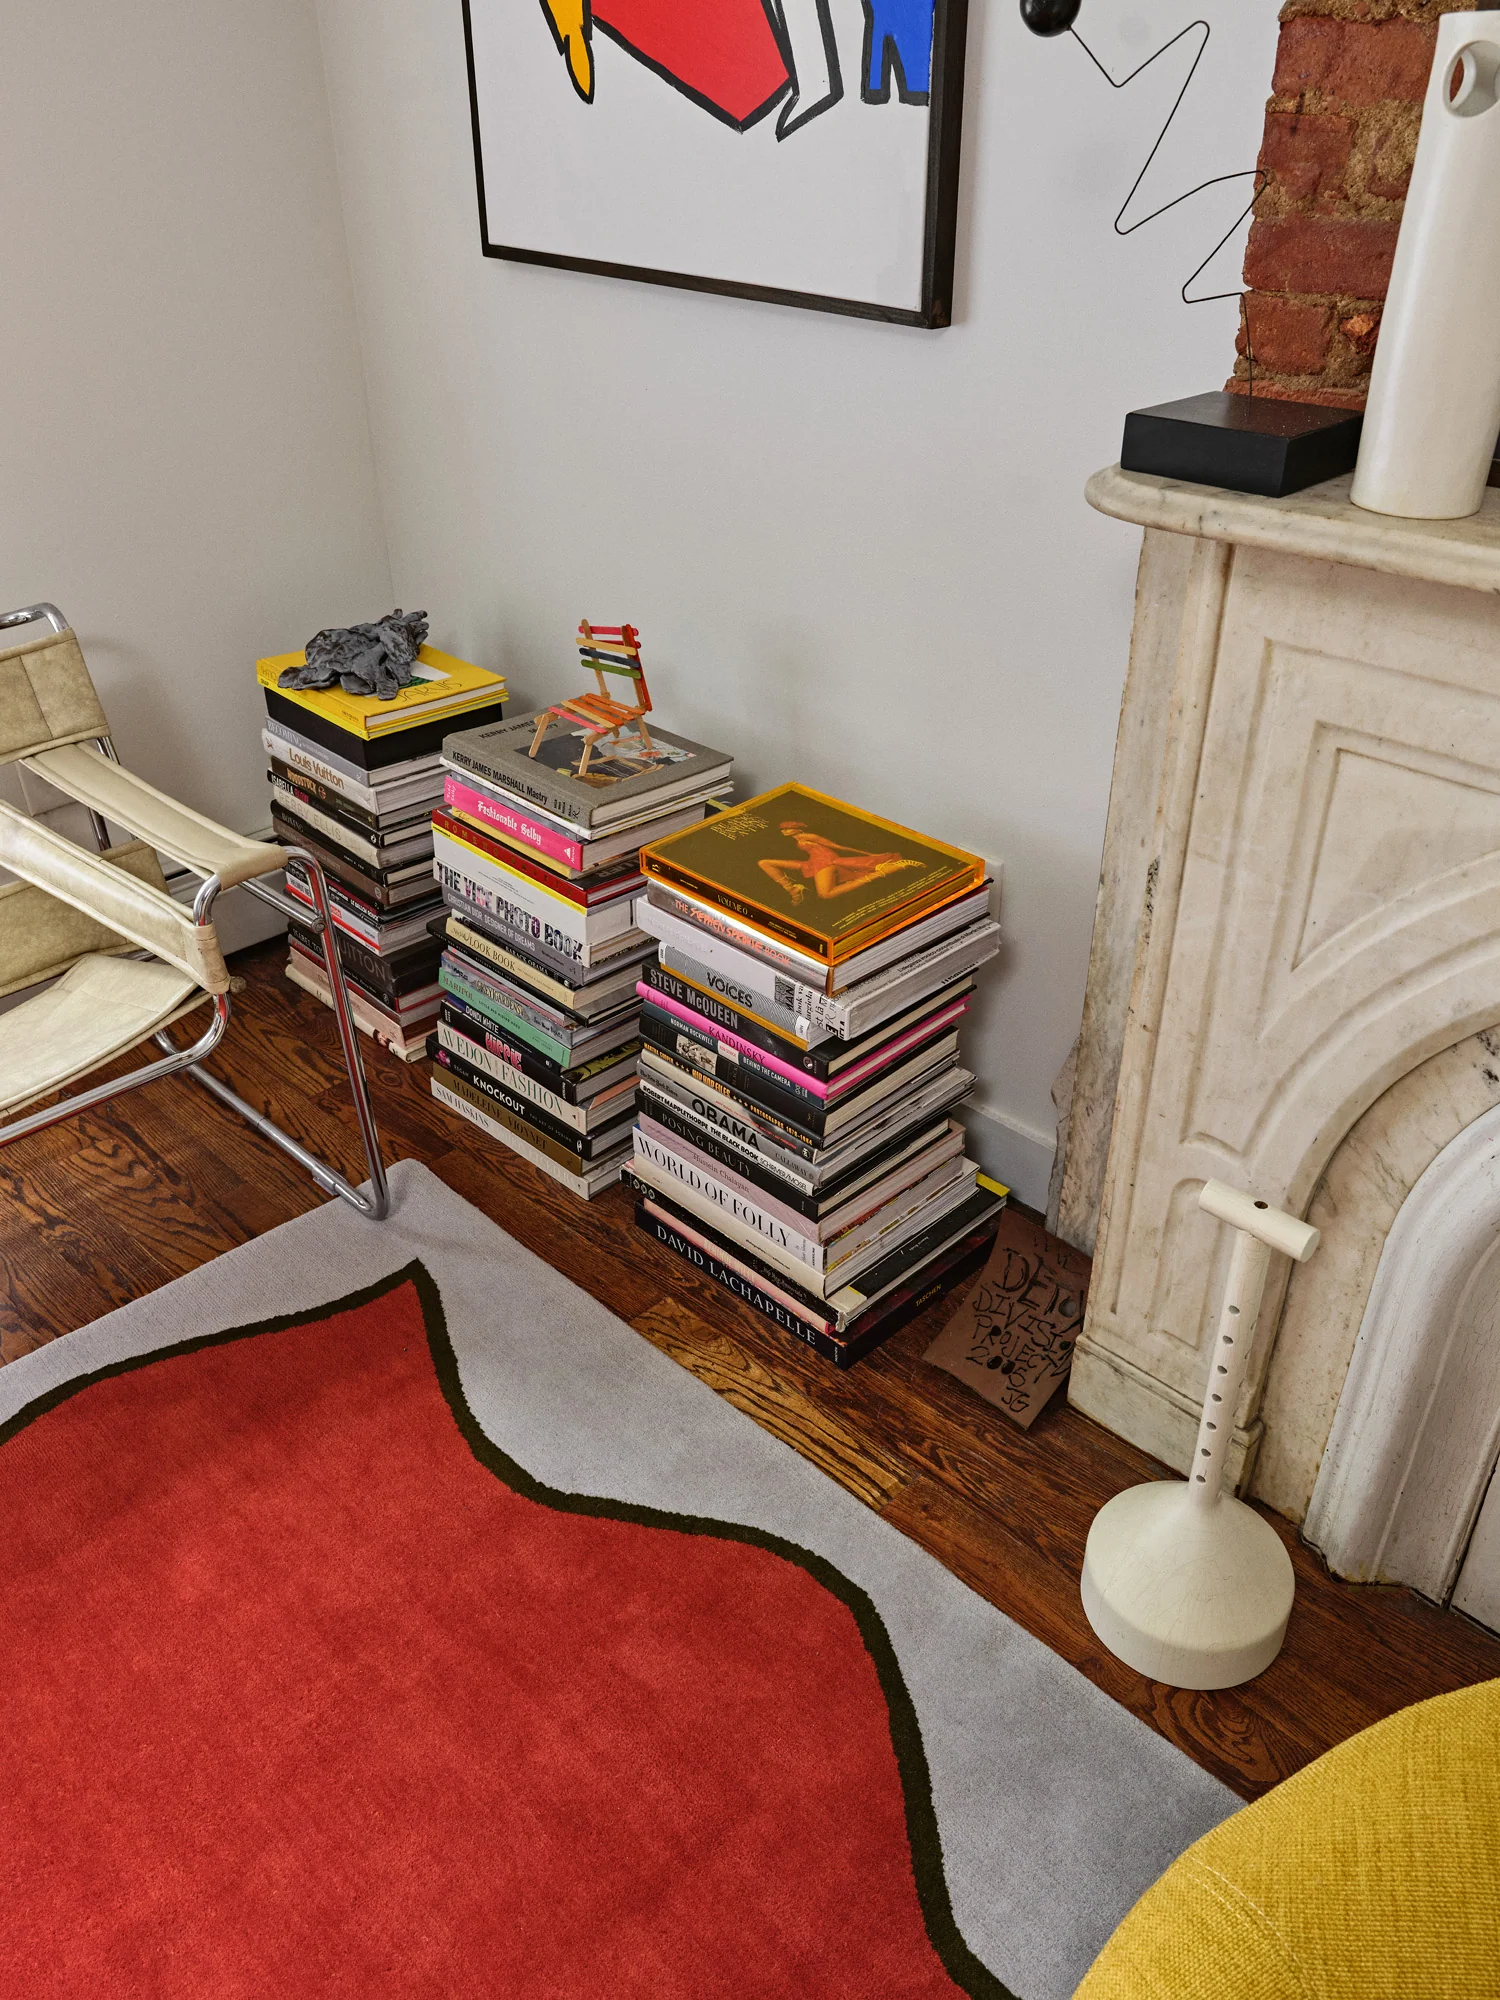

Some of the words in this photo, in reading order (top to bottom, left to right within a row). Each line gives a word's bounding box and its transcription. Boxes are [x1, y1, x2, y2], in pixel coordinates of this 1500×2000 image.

[271, 774, 294, 796] ISABELLA
[289, 747, 312, 772] Louis
[313, 760, 345, 790] Vuitton
[452, 750, 472, 767] KERRY
[471, 758, 492, 777] JAMES
[492, 769, 525, 794] MARSHALL
[526, 785, 548, 806] Mastry
[314, 814, 342, 841] ELLIS
[477, 800, 517, 831] Fashionable
[520, 823, 542, 845] Selby
[436, 860, 461, 893] THE
[463, 876, 493, 913] VICE
[496, 895, 541, 939] PHOTO
[544, 922, 583, 963] BOOK
[468, 936, 491, 957] LOOK
[492, 950, 516, 971] BOOK
[484, 913, 507, 936] DESIGNER
[507, 928, 515, 939] OF
[514, 933, 536, 953] DREAMS
[674, 899, 689, 915] THE
[764, 946, 791, 967] BOOK
[340, 938, 386, 982] UITTON
[505, 946, 527, 964] BARACK
[650, 968, 683, 1000] STEVE
[686, 988, 738, 1030] McQUEEN
[706, 971, 753, 1009] VOICES
[465, 1005, 481, 1021] DONDI
[482, 1015, 499, 1034] WHITE
[670, 1017, 689, 1034] NORMAN
[689, 1027, 713, 1046] ROCKWELL
[708, 1025, 766, 1064] KANDINSKY
[440, 1026, 493, 1075] AVEDON
[501, 1060, 564, 1116] FASHION
[742, 1056, 761, 1071] BEHIND
[761, 1065, 771, 1077] THE
[770, 1070, 791, 1088] CAMERA
[436, 1086, 454, 1104] SAM
[454, 1098, 490, 1128] HASKINS
[452, 1079, 503, 1121] MADELEINE
[507, 1114, 548, 1150] VIONNET
[473, 1074, 525, 1116] KNOCKOUT
[714, 1080, 731, 1098] FILES
[750, 1104, 784, 1130] PHOTOGRAPHS
[642, 1084, 664, 1104] ROBERT
[663, 1096, 709, 1130] MAPPLETHORPE
[710, 1126, 722, 1141] THE
[721, 1132, 740, 1151] BLACK
[740, 1144, 759, 1161] BOOK
[692, 1098, 760, 1151] OBAMA
[661, 1112, 704, 1147] POSING
[707, 1142, 751, 1178] BEAUTY
[775, 1152, 809, 1178] CALLAWAY
[638, 1135, 701, 1190] WORLD
[704, 1181, 729, 1206] OF
[732, 1200, 791, 1247] FOLLY
[693, 1153, 719, 1173] Hussein
[719, 1168, 750, 1194] Chalayan
[656, 1224, 704, 1266] DAVID
[710, 1261, 816, 1345] LACHAPELLE
[914, 1284, 942, 1308] TASCHEN
